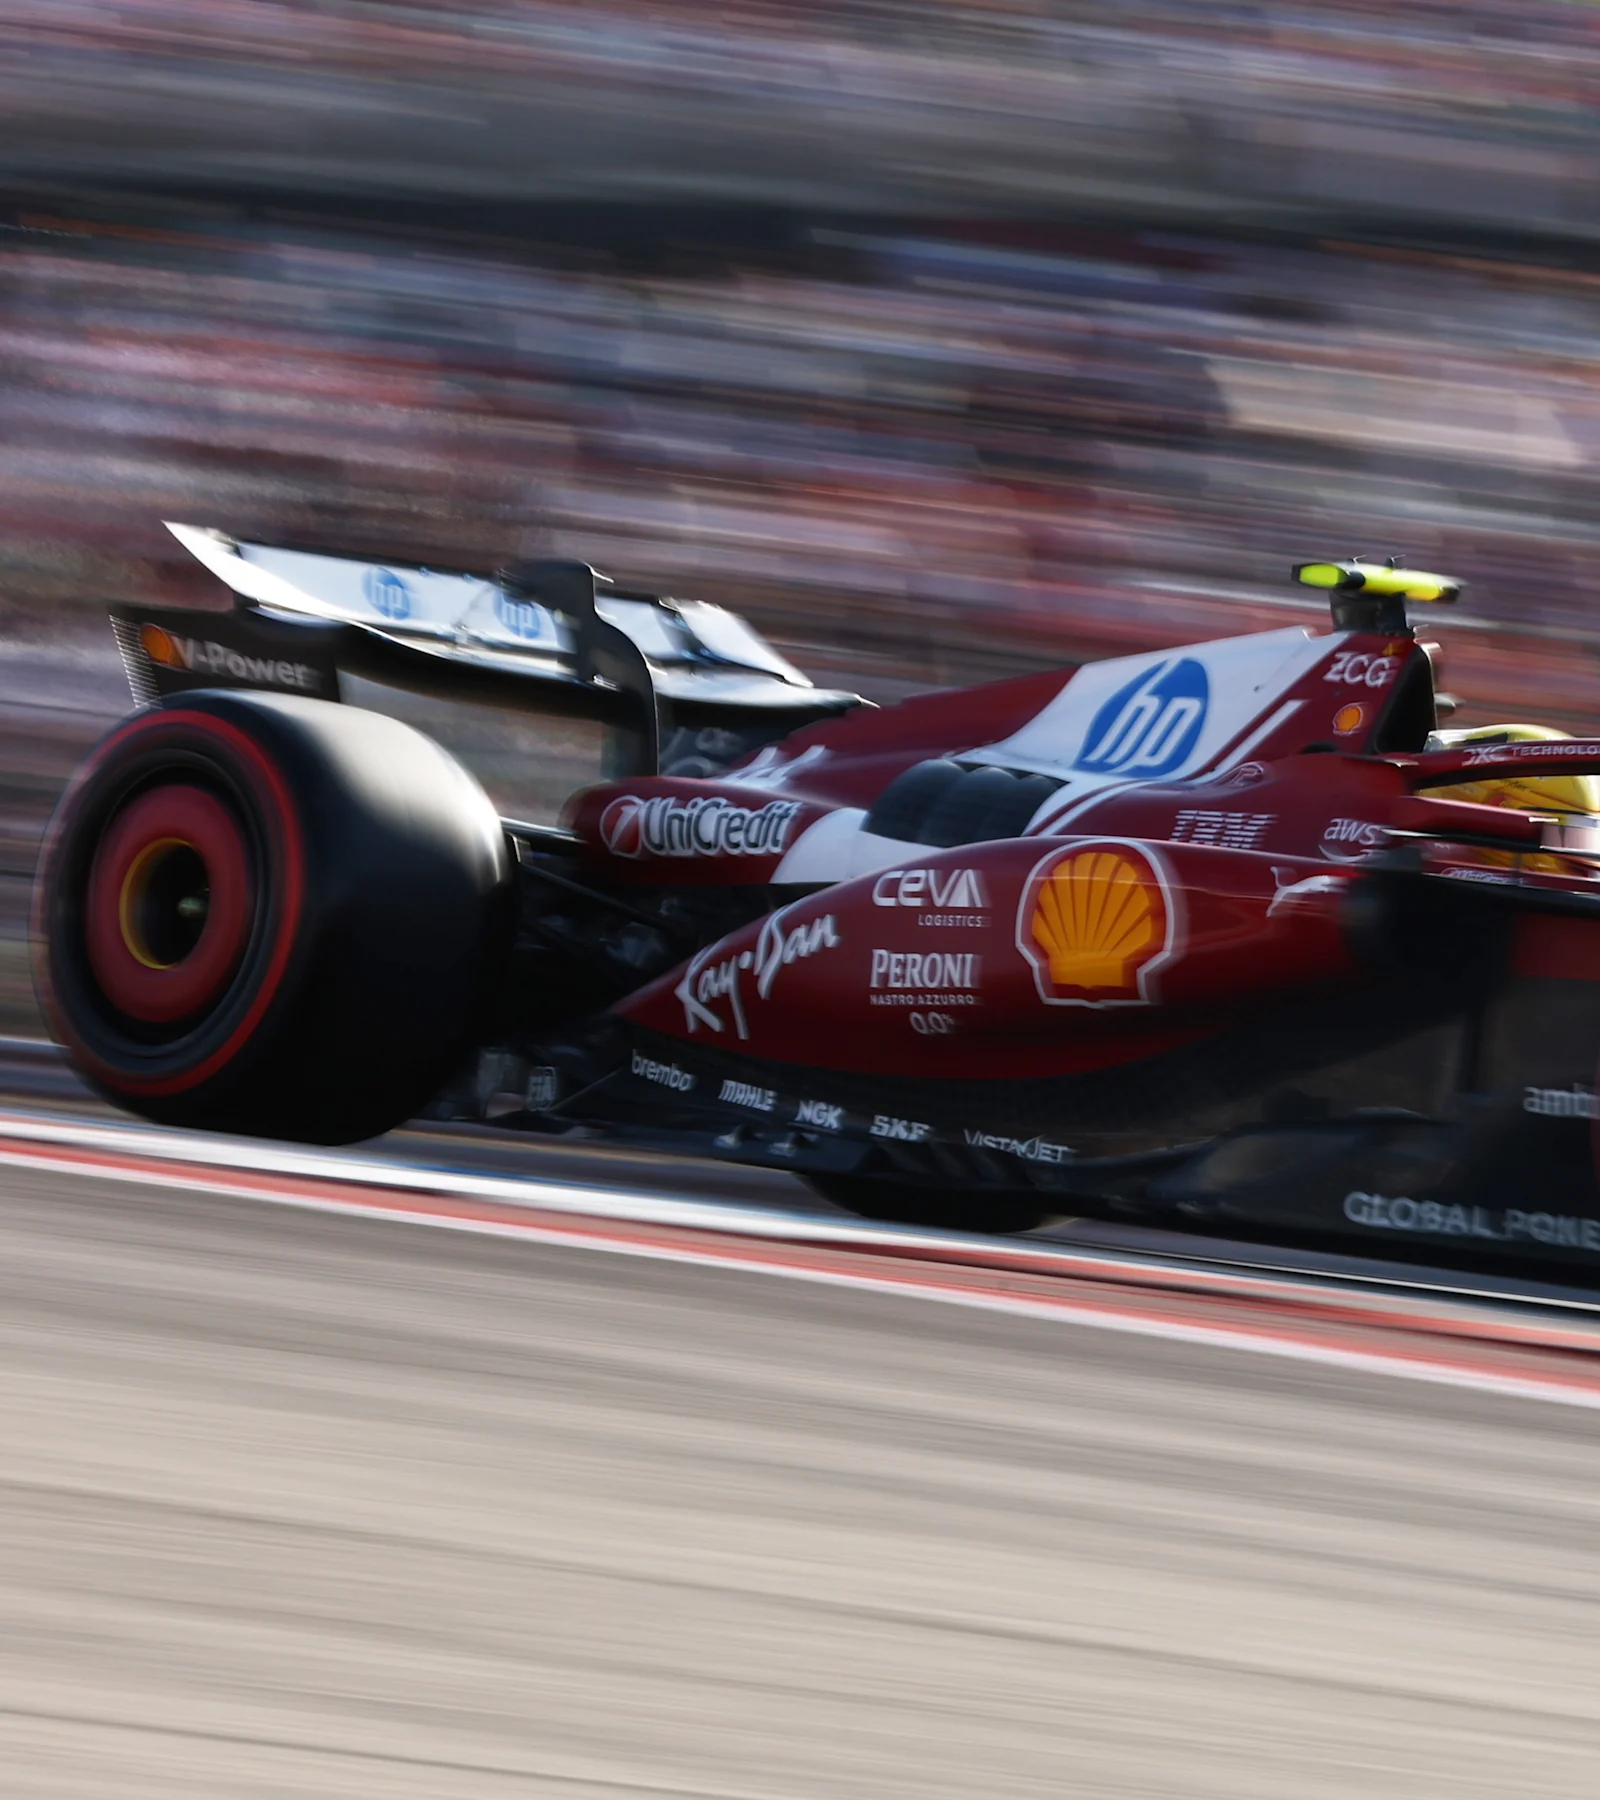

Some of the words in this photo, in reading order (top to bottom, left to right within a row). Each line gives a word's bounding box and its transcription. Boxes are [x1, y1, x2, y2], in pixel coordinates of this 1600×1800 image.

[172, 635, 315, 689] V-Power
[1323, 652, 1395, 687] ZCG
[641, 799, 802, 853] UniCredit
[1169, 810, 1278, 848] IBM
[917, 914, 986, 927] LOGISTICS
[869, 949, 976, 988] PERONI
[869, 994, 914, 1005] NASTRO
[917, 994, 979, 1006] AZZURRO
[631, 1050, 693, 1091] brembo
[718, 1079, 777, 1112] MAHLE
[795, 1101, 846, 1129] NGK
[869, 1115, 933, 1142] SKF
[1343, 1191, 1500, 1240] GLOBAL
